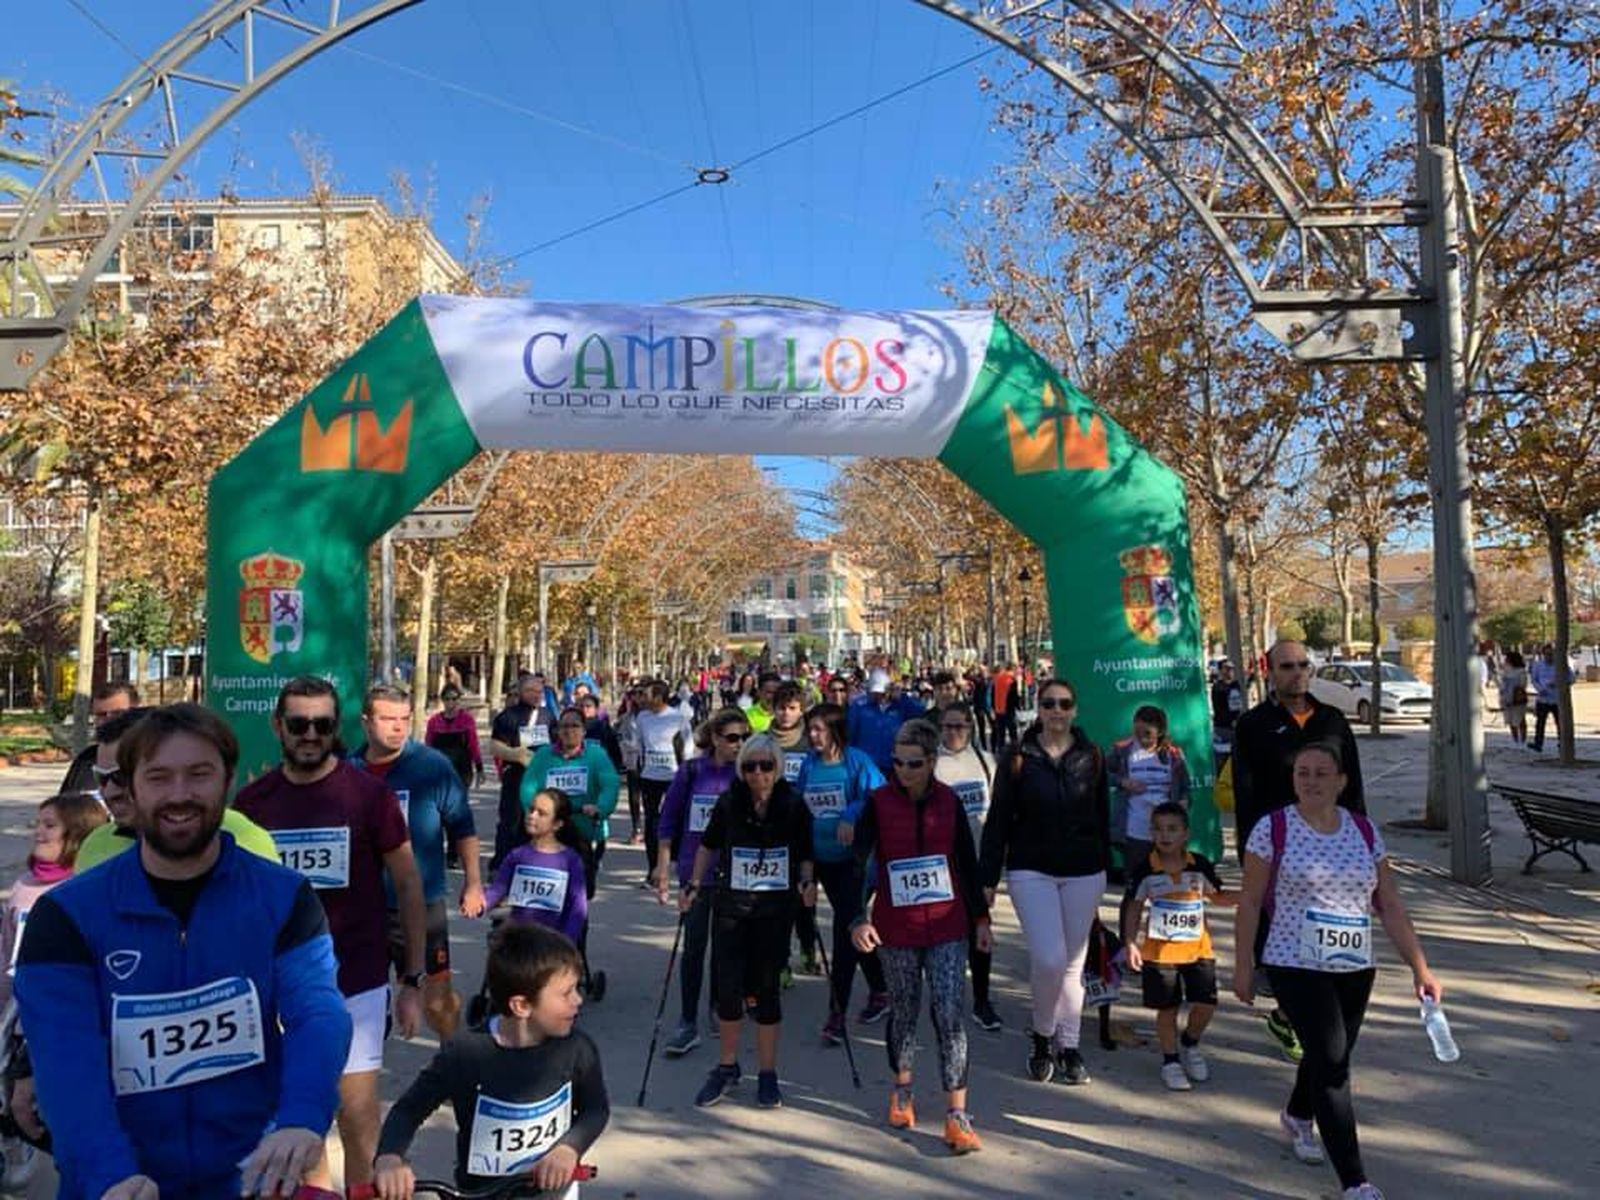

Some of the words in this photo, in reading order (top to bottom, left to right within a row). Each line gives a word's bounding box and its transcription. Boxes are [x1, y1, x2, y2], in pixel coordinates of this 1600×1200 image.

[524, 392, 611, 408] TODO
[621, 394, 660, 409] LO
[668, 395, 733, 410] QUE
[743, 396, 905, 411] NECESITAS
[1115, 677, 1187, 694] Campillos
[280, 848, 332, 870] 1153
[742, 862, 780, 877] 1432
[522, 880, 556, 897] 1167
[901, 871, 939, 890] 1431
[1316, 928, 1363, 950] 1500
[140, 1010, 238, 1059] 1325
[492, 1117, 558, 1152] 1324
